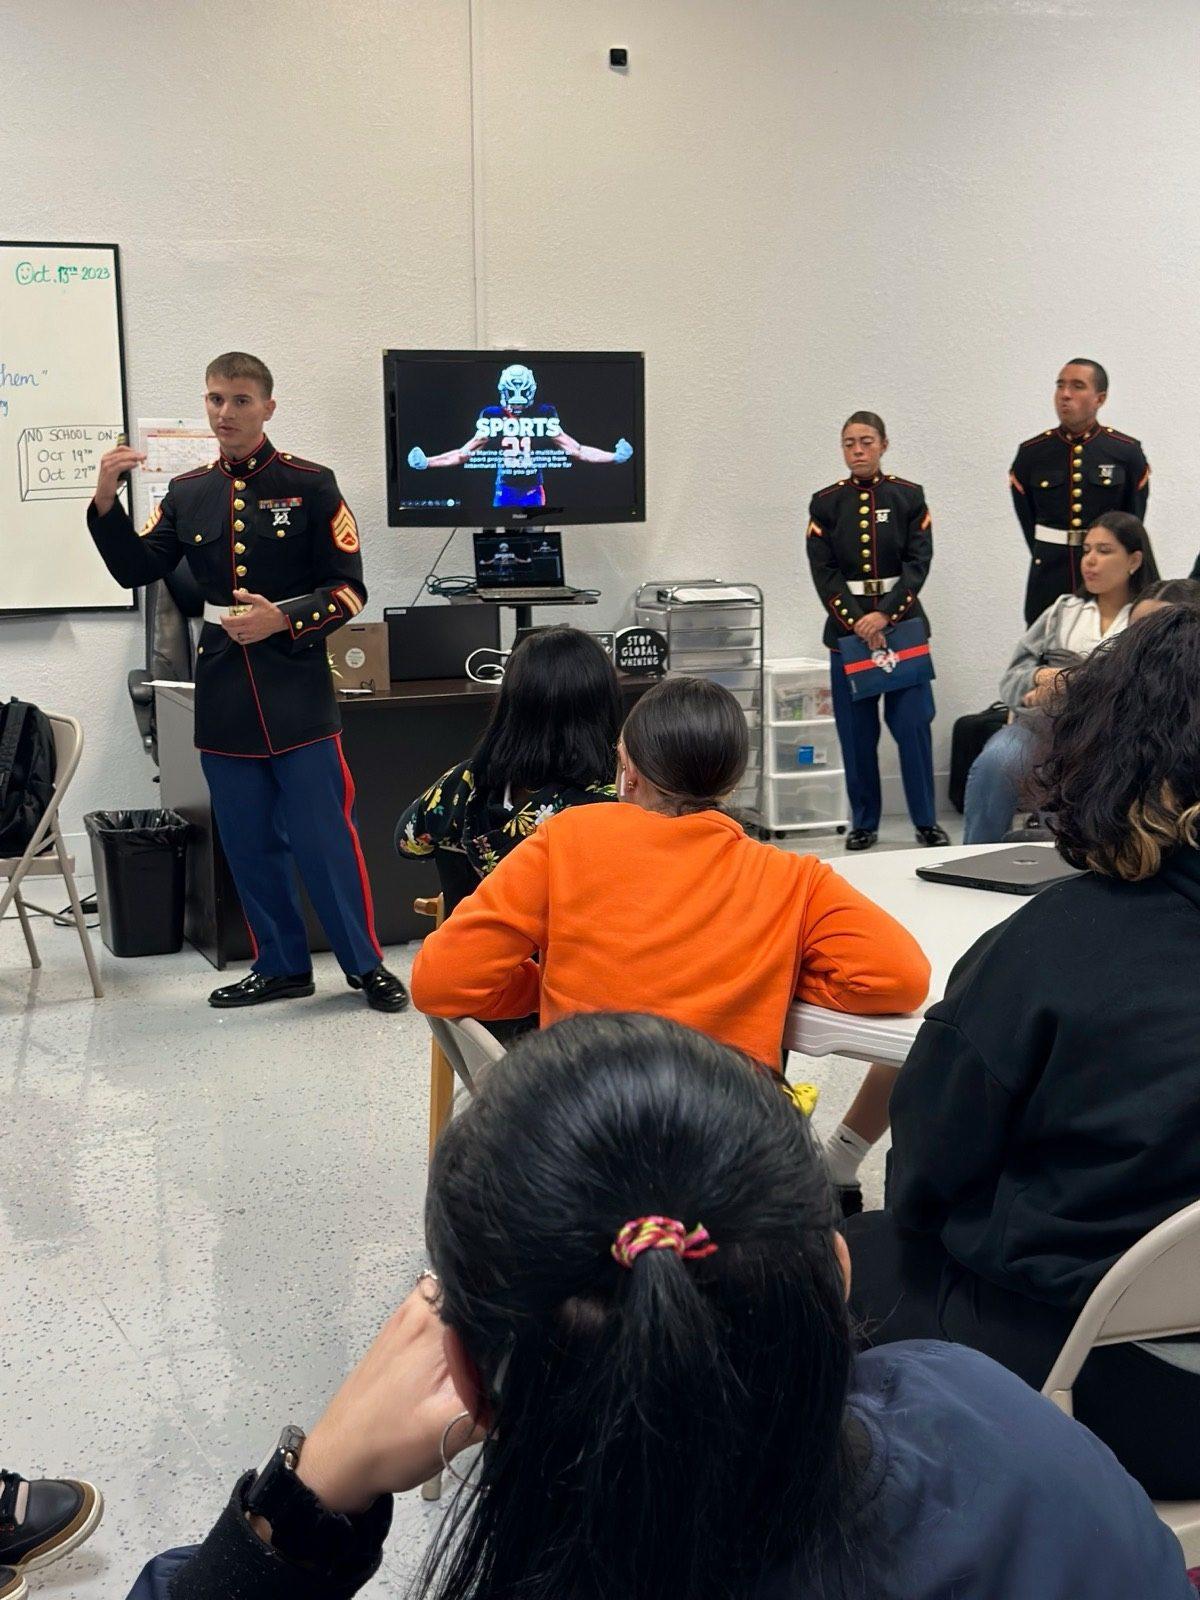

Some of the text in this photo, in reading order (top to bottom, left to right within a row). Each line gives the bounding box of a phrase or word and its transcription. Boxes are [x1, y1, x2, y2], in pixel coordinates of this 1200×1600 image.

[81, 266, 110, 280] 2023
[476, 418, 560, 437] SPORTS
[28, 429, 43, 442] NO
[50, 429, 92, 441] SCHOOL
[627, 635, 651, 646] STOP
[621, 645, 658, 657] GLOBAL
[620, 656, 659, 667] WHINING
